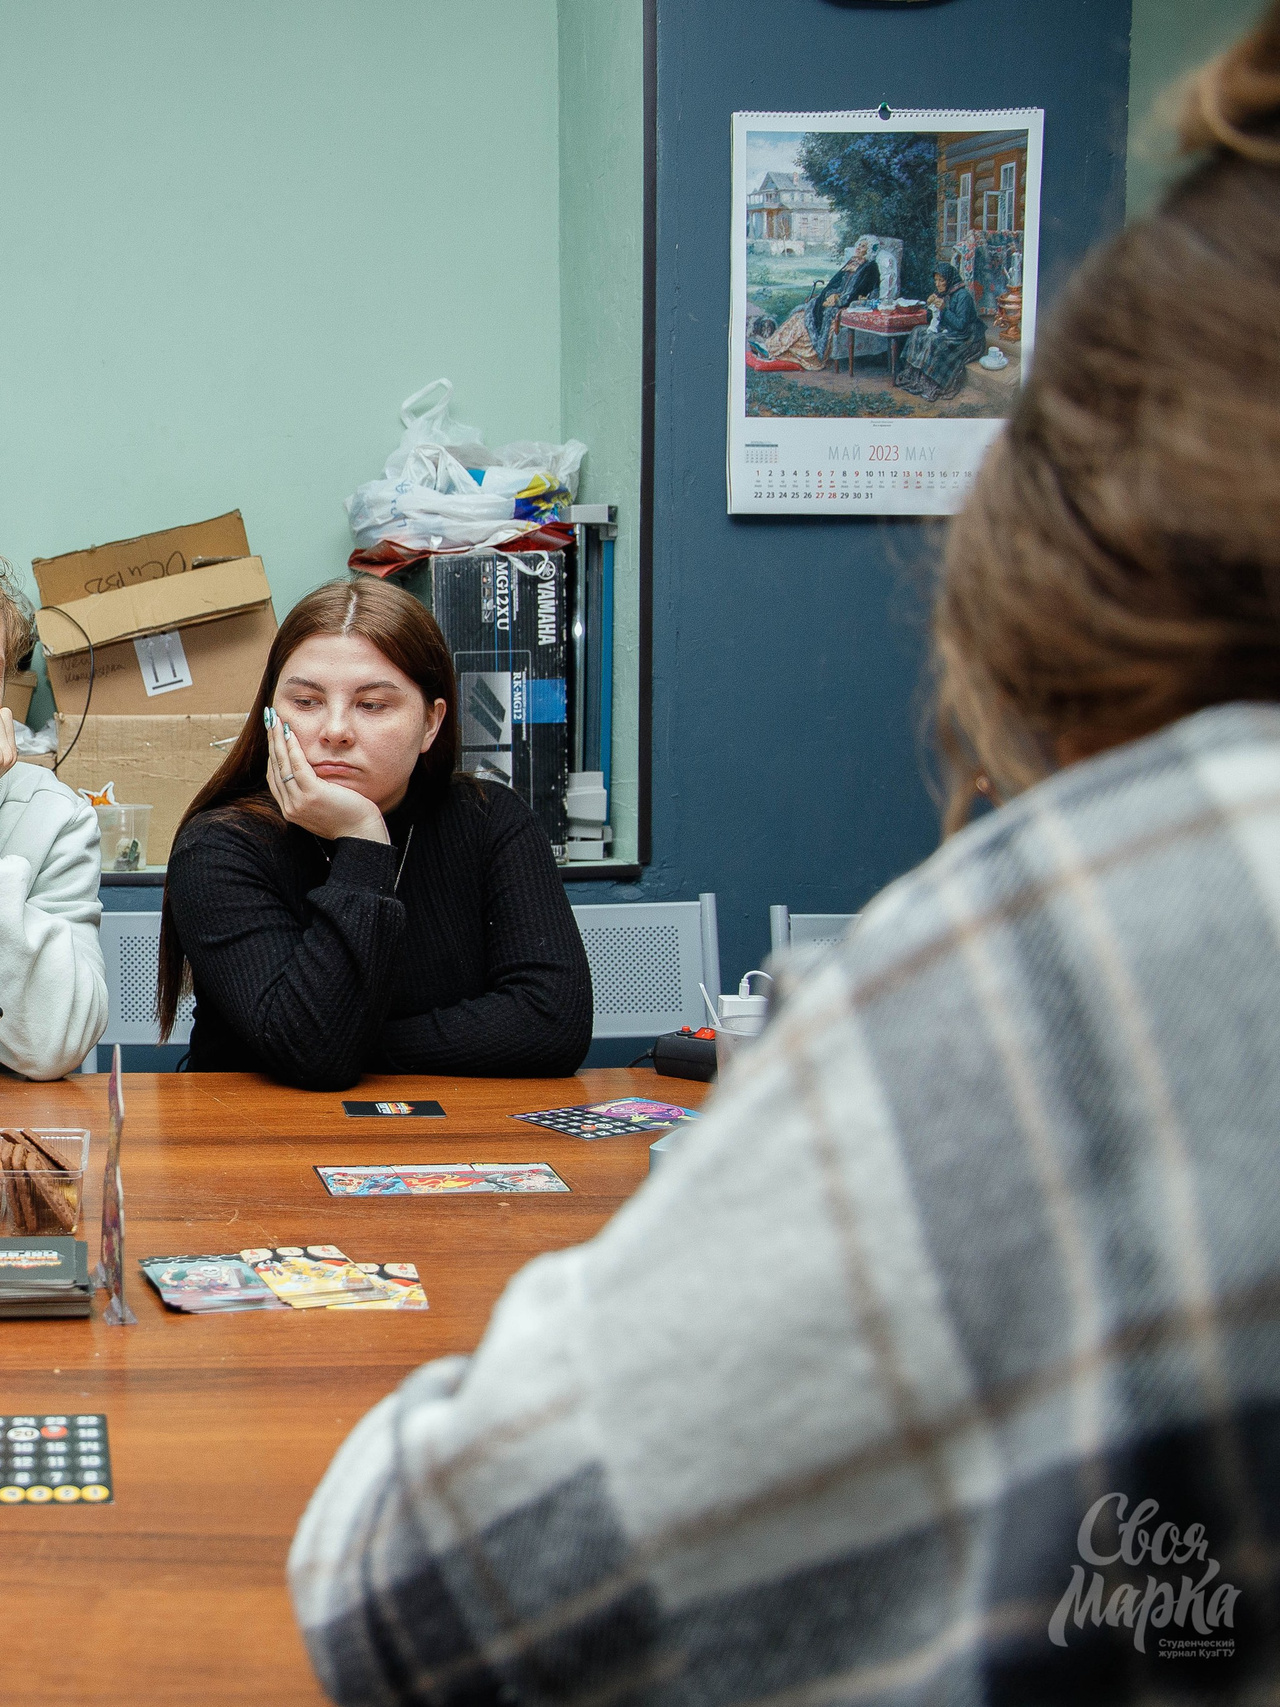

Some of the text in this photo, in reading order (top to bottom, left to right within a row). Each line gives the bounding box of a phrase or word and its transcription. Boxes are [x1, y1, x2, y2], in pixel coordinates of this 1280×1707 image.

[828, 444, 936, 461] МАЙ 2023 MAY
[496, 560, 510, 631] MG12XU
[537, 580, 557, 647] YAMAHA
[512, 671, 522, 720] RK-MG12
